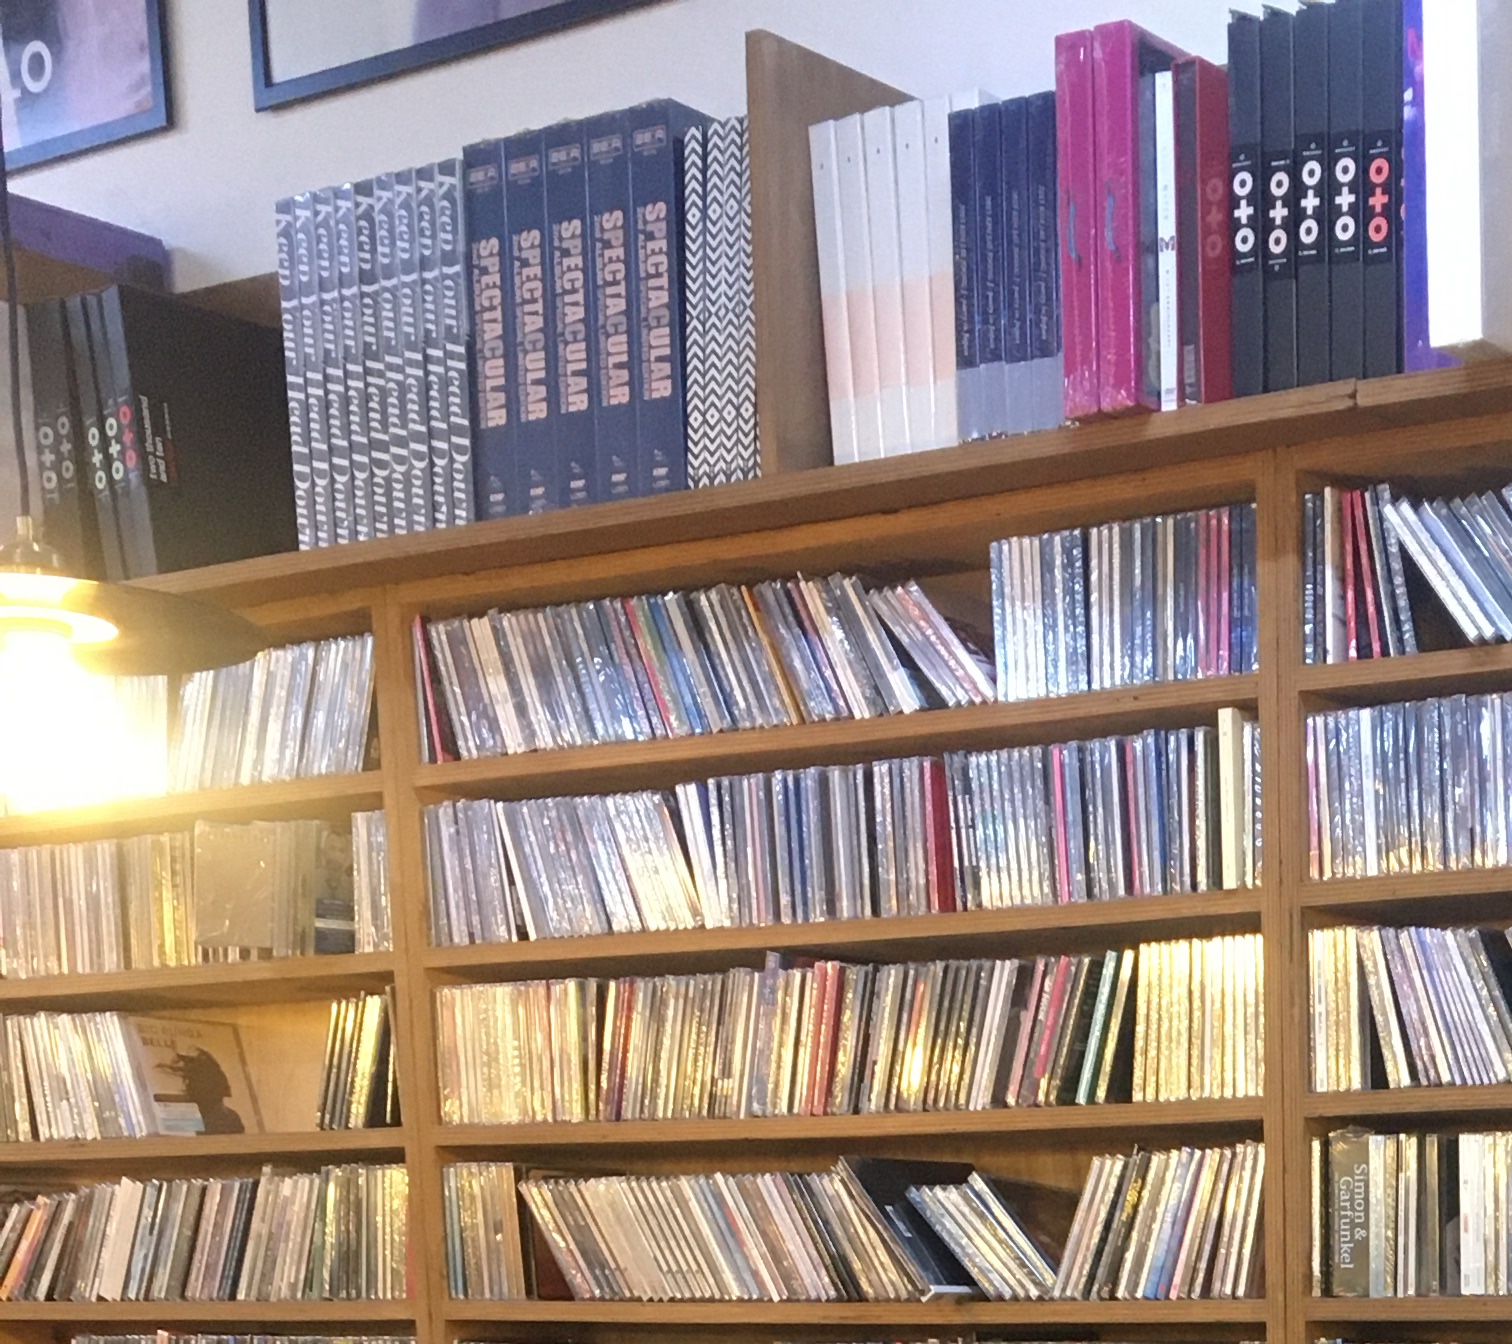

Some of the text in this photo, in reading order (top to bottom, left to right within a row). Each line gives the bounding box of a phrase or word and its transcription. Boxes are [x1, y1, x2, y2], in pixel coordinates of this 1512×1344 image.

[276, 212, 292, 286] Keep
[294, 206, 312, 283] Keep
[315, 202, 332, 278] Keep
[335, 200, 353, 273] Keep
[355, 194, 374, 271] Keep
[375, 190, 395, 264] Keep
[395, 184, 413, 260] Keep
[417, 180, 434, 255] Keep
[436, 172, 458, 252] Keep
[281, 300, 298, 366] Your
[301, 295, 318, 361] Your
[321, 291, 338, 358] Your
[341, 287, 358, 354] Your
[361, 284, 379, 351] Your
[381, 278, 398, 346] Your
[400, 273, 417, 341] Your
[422, 270, 439, 338] Your
[441, 265, 461, 334] Your
[478, 236, 507, 428] SPECTACULAR
[520, 228, 548, 422] SPECTACULAR
[561, 218, 590, 413] SPECTACULAR
[601, 208, 630, 406] SPECTACULAR
[644, 200, 674, 400] SPECTACULAR
[287, 375, 306, 453] Head
[306, 371, 327, 450] Head
[326, 367, 346, 447] Head
[346, 364, 367, 443] Head
[365, 360, 388, 440] Head
[385, 355, 407, 439] Head
[404, 352, 426, 432] Head
[427, 347, 448, 430] Head
[445, 343, 470, 425] Head
[1340, 1176, 1354, 1269] Garfunkel
[1353, 1163, 1368, 1241] Simon &
